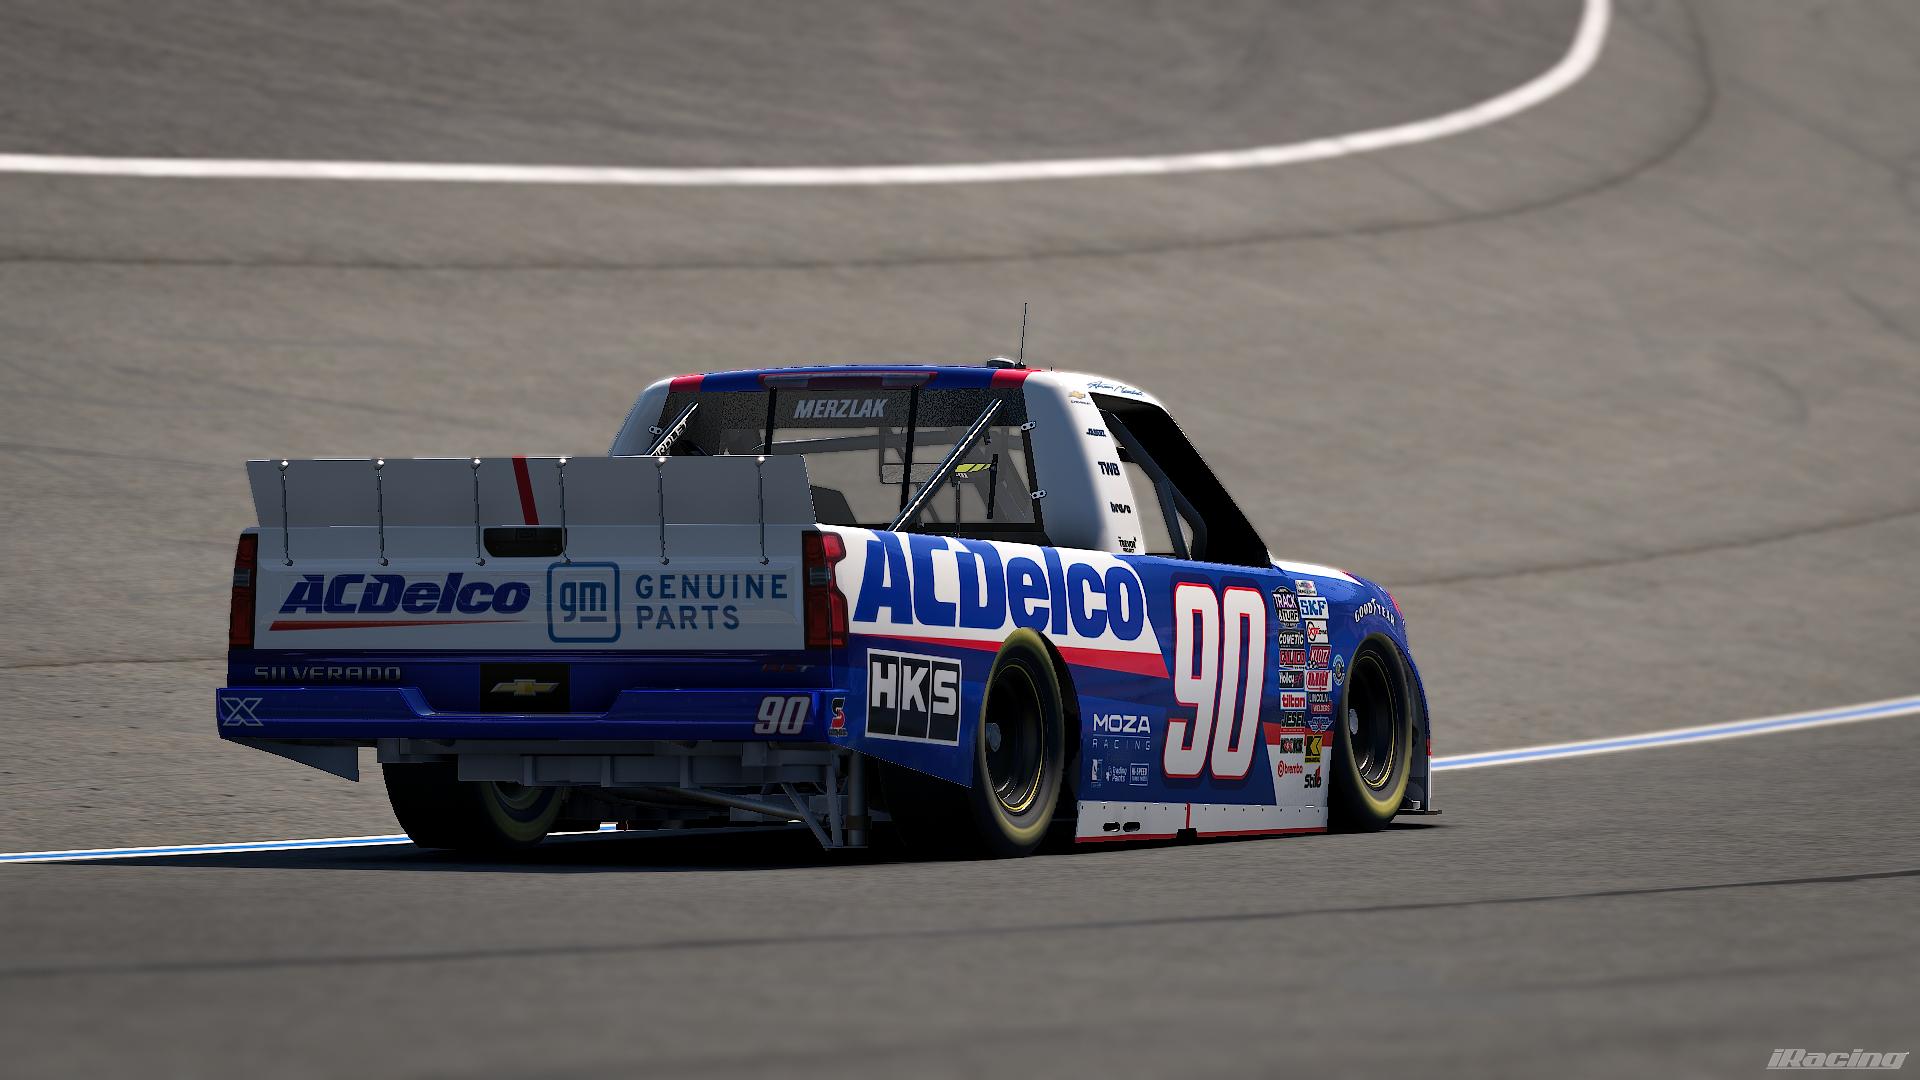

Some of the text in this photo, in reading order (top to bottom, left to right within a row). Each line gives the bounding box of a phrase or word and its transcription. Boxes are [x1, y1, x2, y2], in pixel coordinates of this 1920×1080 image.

[793, 399, 889, 418] MERZLAK
[1098, 461, 1120, 476] TWB
[278, 572, 531, 614] ACDelco
[635, 574, 788, 599] GENUINE
[853, 531, 1144, 641] ACDelco
[559, 582, 608, 622] gm
[1300, 599, 1326, 616] SKF
[1354, 597, 1396, 626] GOODYEAR
[636, 605, 740, 630] PARTS
[254, 665, 401, 681] SILVERADO
[1162, 581, 1267, 779] 90
[871, 660, 957, 717] HKS
[754, 696, 811, 734] 90
[1093, 713, 1151, 734] MOZA
[1092, 738, 1151, 751] RACING
